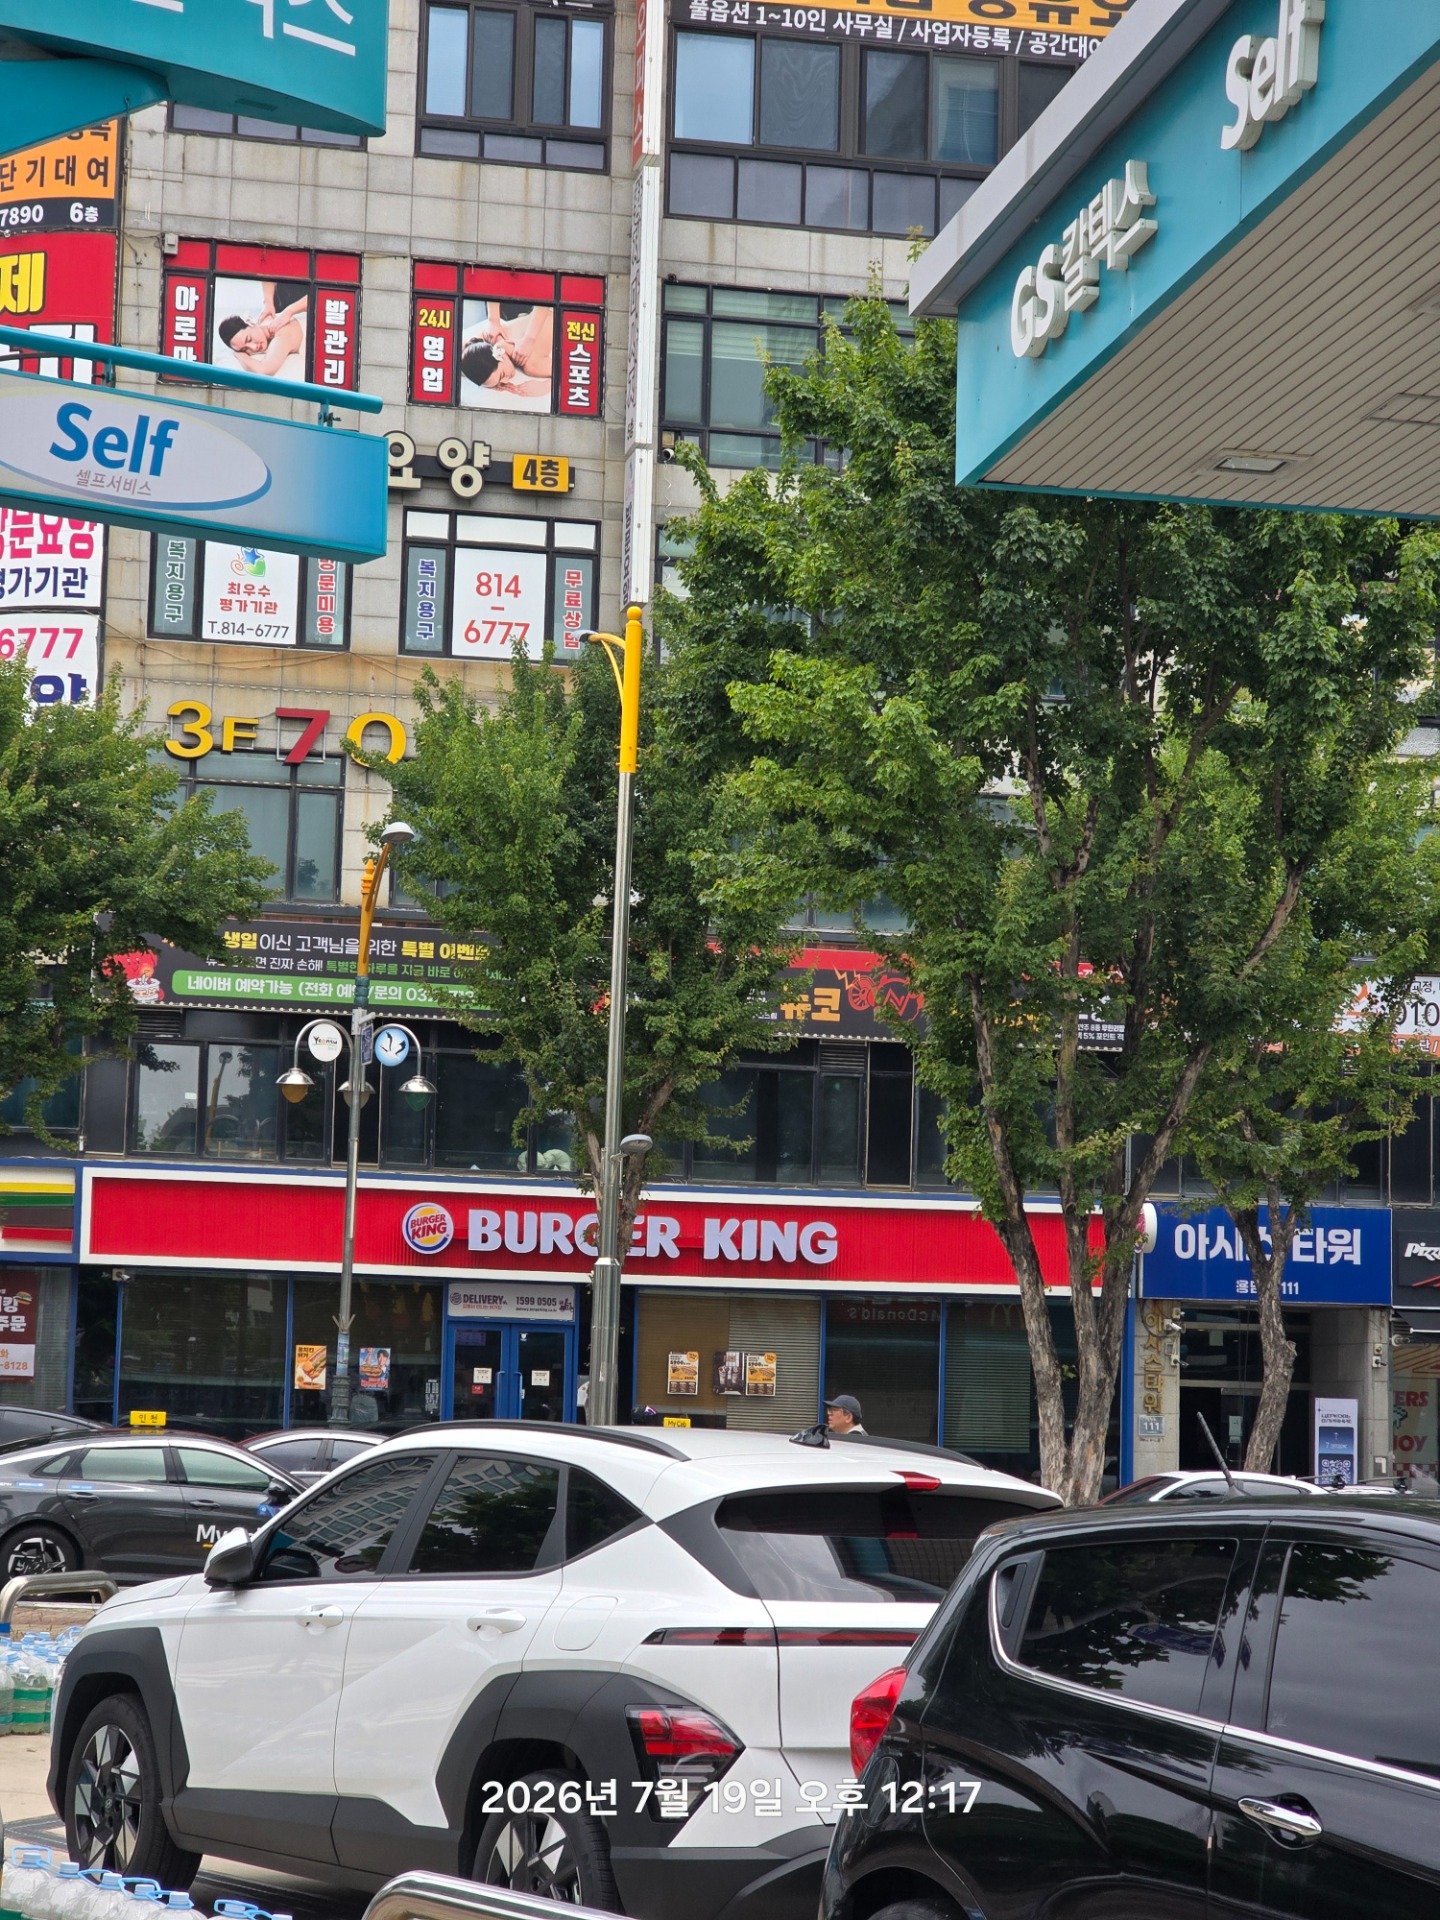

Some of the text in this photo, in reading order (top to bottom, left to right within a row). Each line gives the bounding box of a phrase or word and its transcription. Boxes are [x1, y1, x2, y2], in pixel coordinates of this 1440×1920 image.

[689, 0, 750, 25] 풀옵션
[755, 6, 826, 32] 1~10인
[833, 12, 893, 40] 사무실
[911, 20, 1012, 51] 사업자등록
[1220, 0, 1325, 151] Self
[69, 201, 99, 223] 6층
[418, 308, 451, 329] 24시
[323, 298, 350, 385] 발관리
[566, 321, 596, 342] 전신
[421, 335, 445, 393] 영업
[567, 343, 592, 408] 스포츠
[49, 402, 180, 477] Self
[76, 469, 152, 496] 셀프서비스
[522, 458, 560, 488] 4층
[165, 539, 188, 624] 복지용구
[226, 581, 271, 598] 최우수
[475, 571, 522, 599] 814
[219, 598, 279, 615] 평가기관
[417, 558, 437, 640] 복지용구
[207, 620, 290, 639] T.814-6777
[463, 619, 531, 646] 6777
[295, 935, 360, 956] 고객님을
[401, 940, 435, 959] 특별
[269, 957, 294, 970] 진짜
[427, 966, 451, 979] 바로
[187, 974, 231, 992] 네이버
[234, 978, 294, 996] 예약가능
[297, 981, 333, 998] (전화
[1096, 1032, 1116, 1041] 포인트
[410, 1214, 447, 1229] BURGER
[411, 1222, 448, 1241] KING
[703, 1217, 839, 1265] KING
[1281, 1281, 1299, 1295] 111
[516, 1296, 535, 1306] 1599
[537, 1297, 557, 1307] 0505
[138, 1414, 158, 1424] 인천
[1143, 1422, 1160, 1431] 111
